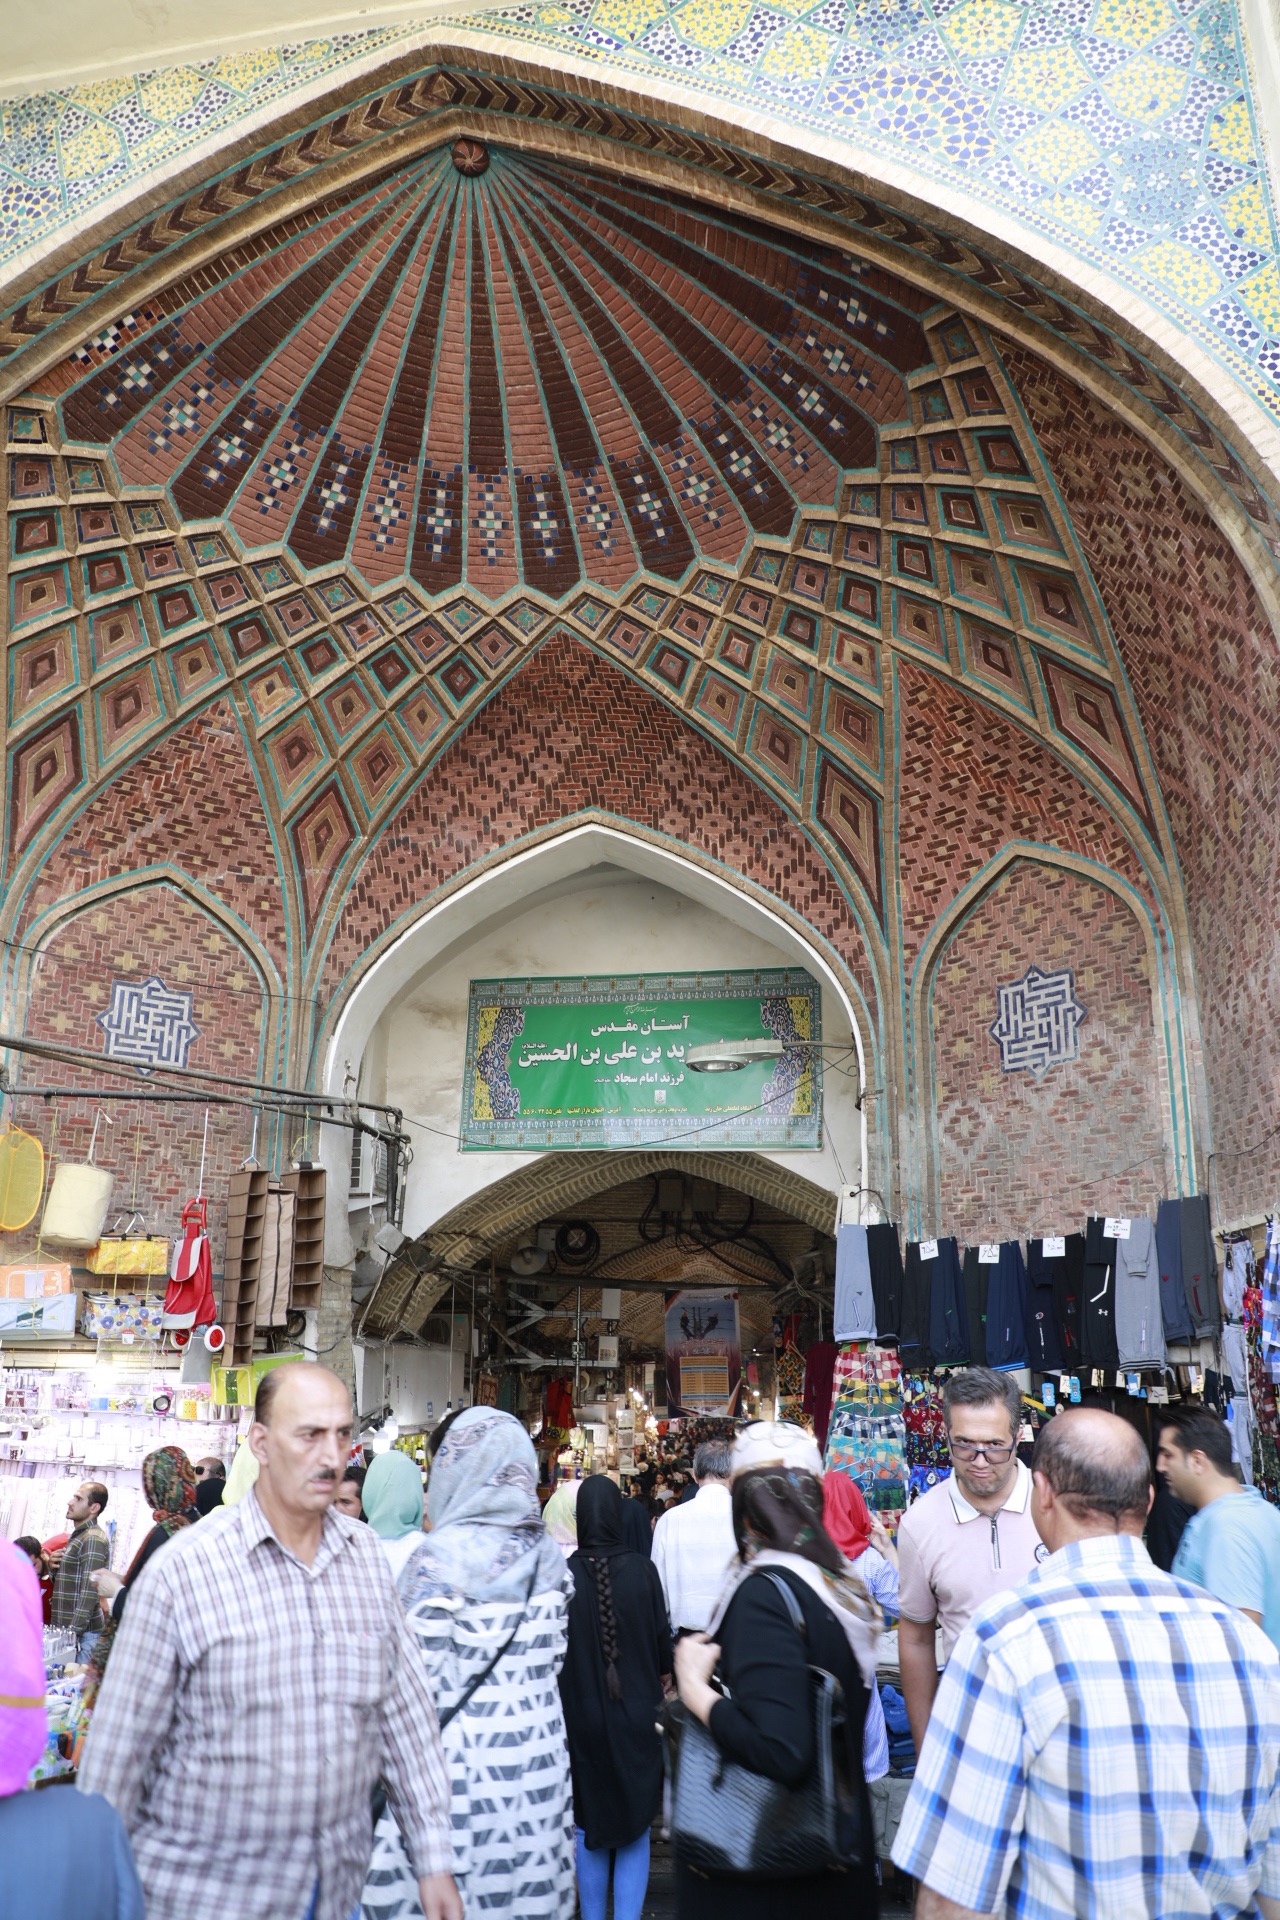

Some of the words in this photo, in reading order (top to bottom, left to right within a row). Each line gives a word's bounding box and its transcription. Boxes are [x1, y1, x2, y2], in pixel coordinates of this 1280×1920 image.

[590, 1018, 638, 1036] مقدس
[640, 1014, 691, 1035] آستان
[518, 1042, 578, 1067] الحسین
[580, 1044, 601, 1065] بن
[604, 1040, 638, 1065] علی
[641, 1044, 662, 1064] بن
[666, 1042, 692, 1062] ید
[614, 1072, 638, 1086] سجاد
[639, 1072, 658, 1086] امام
[660, 1071, 685, 1086] فرزند
